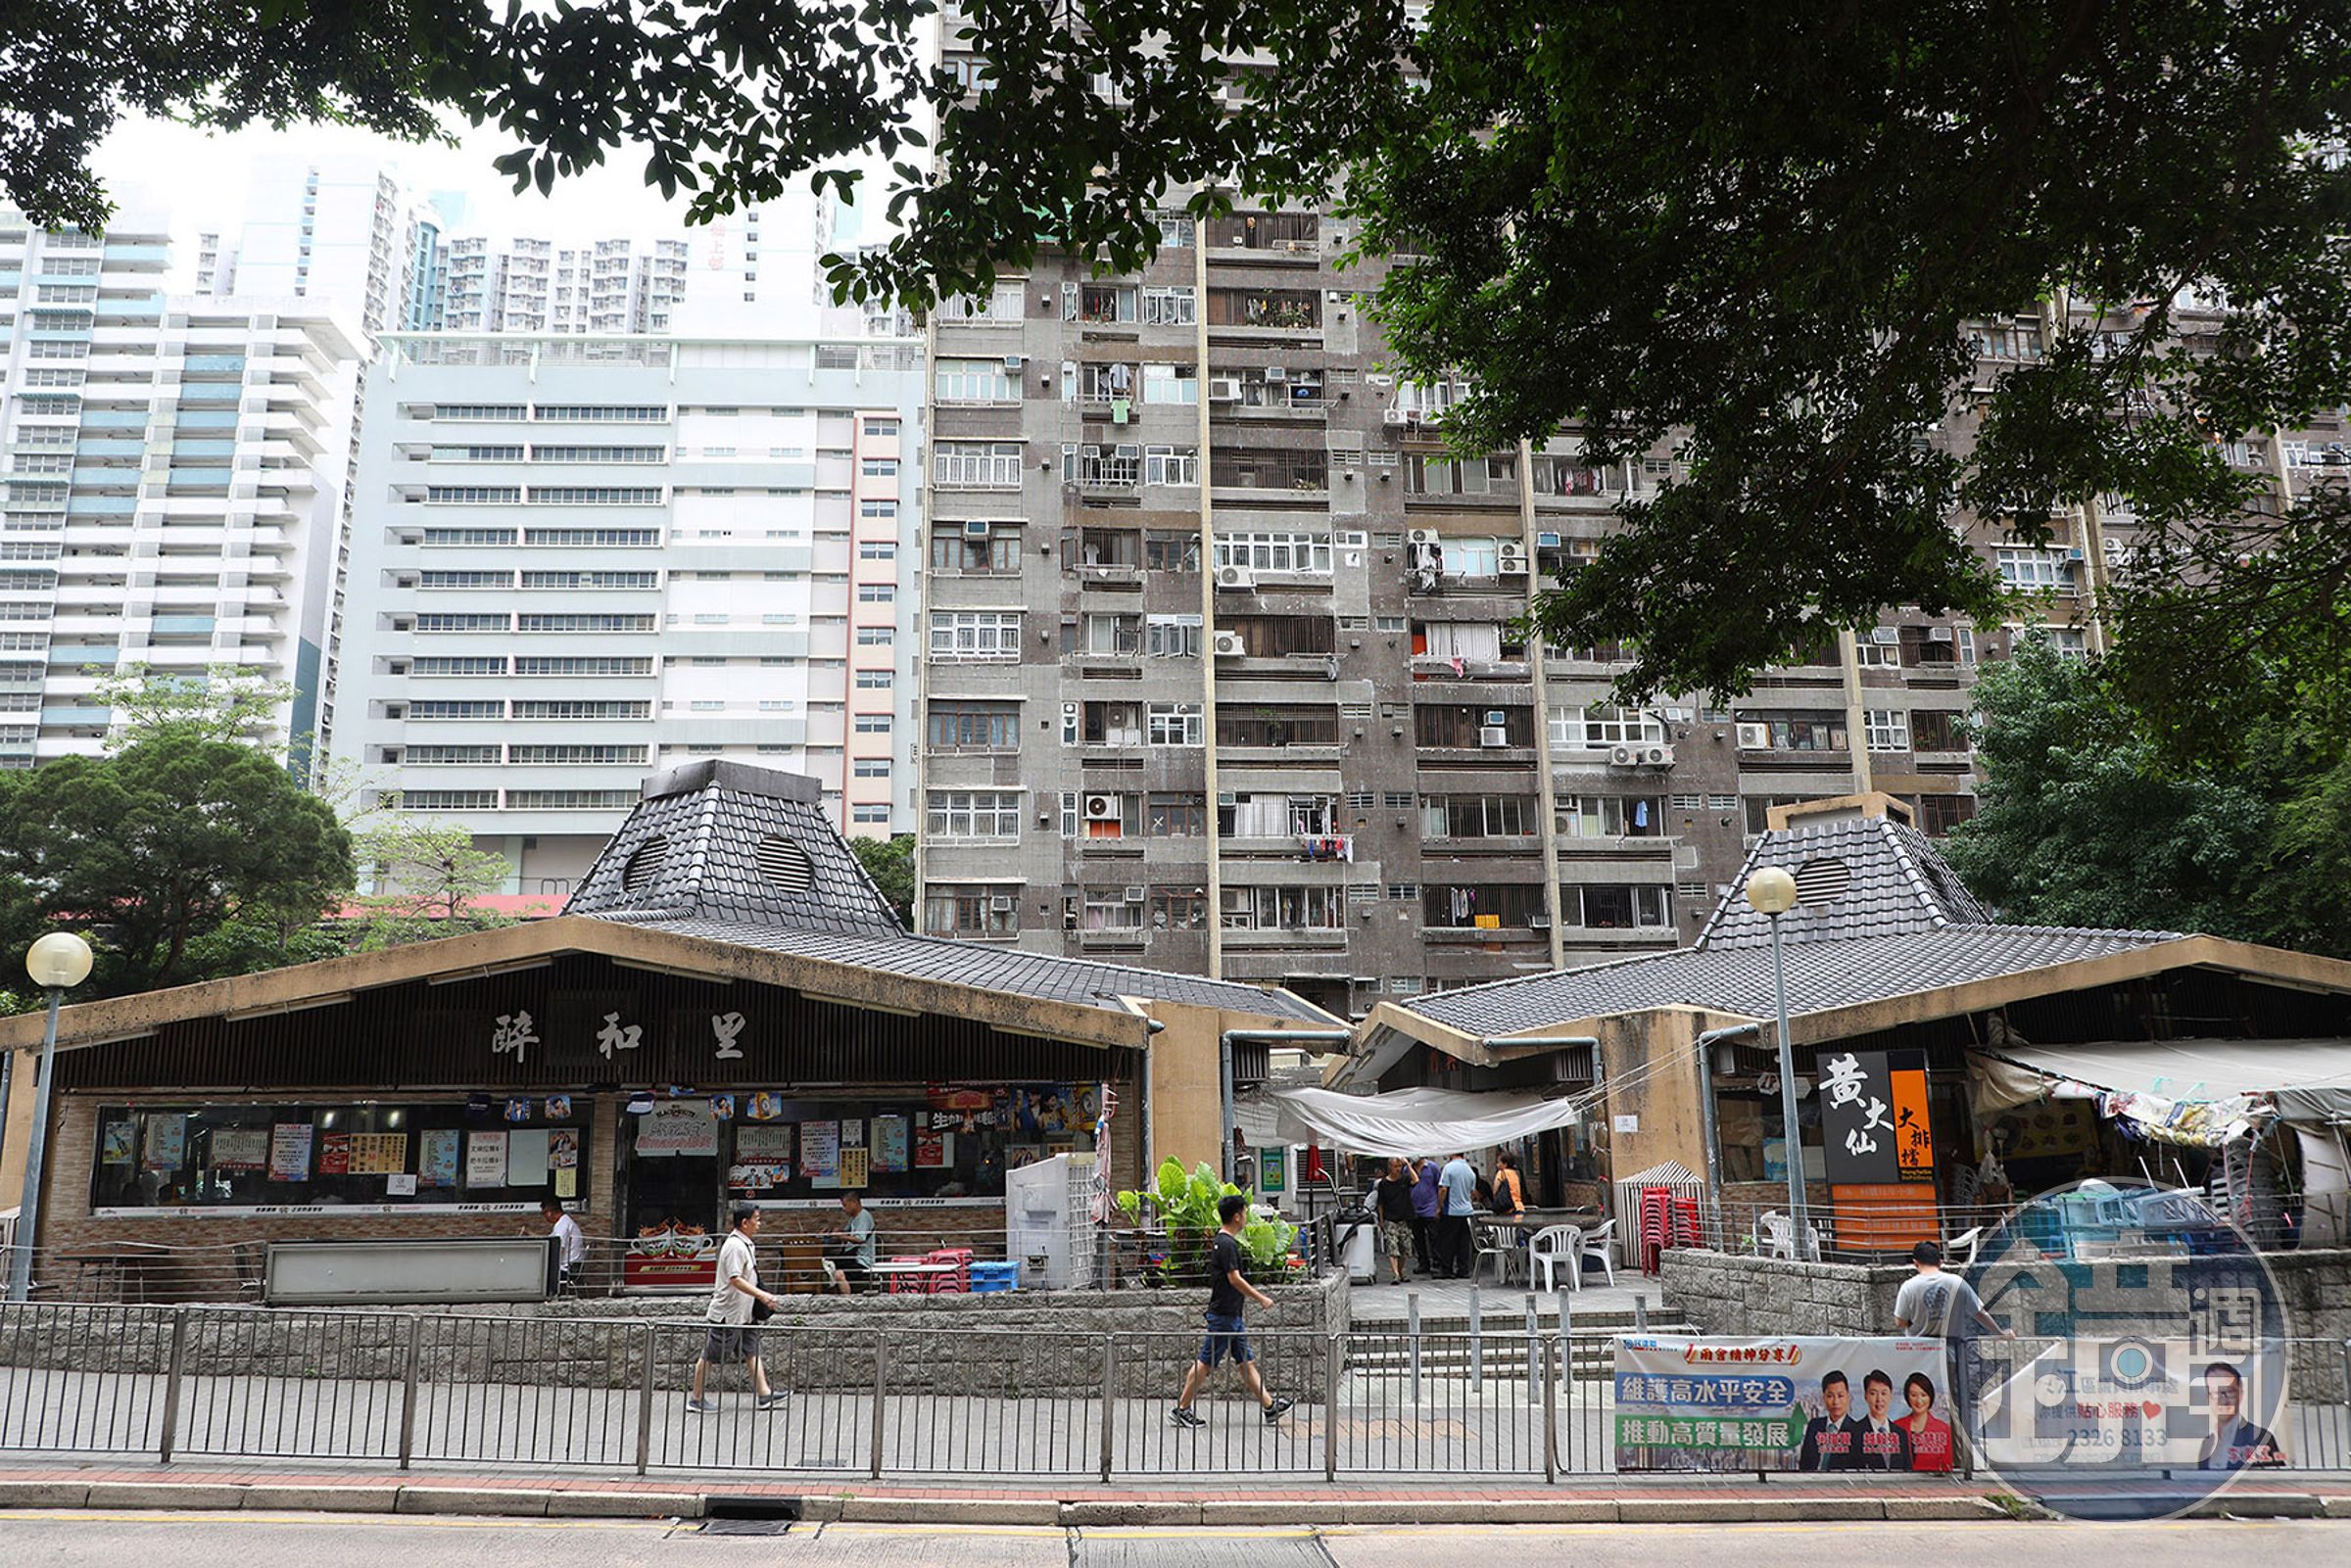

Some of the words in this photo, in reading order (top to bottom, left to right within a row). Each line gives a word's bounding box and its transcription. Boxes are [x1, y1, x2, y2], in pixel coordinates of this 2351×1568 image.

[1818, 1053, 1895, 1156] 黃大仙
[1700, 1348, 1786, 1362] 兩會精神分享
[1622, 1376, 1788, 1405] 維護高水平安全
[1622, 1421, 1789, 1448] 推動高質量發展
[2067, 1428, 2115, 1447] 2326
[2121, 1428, 2168, 1447] 8133
